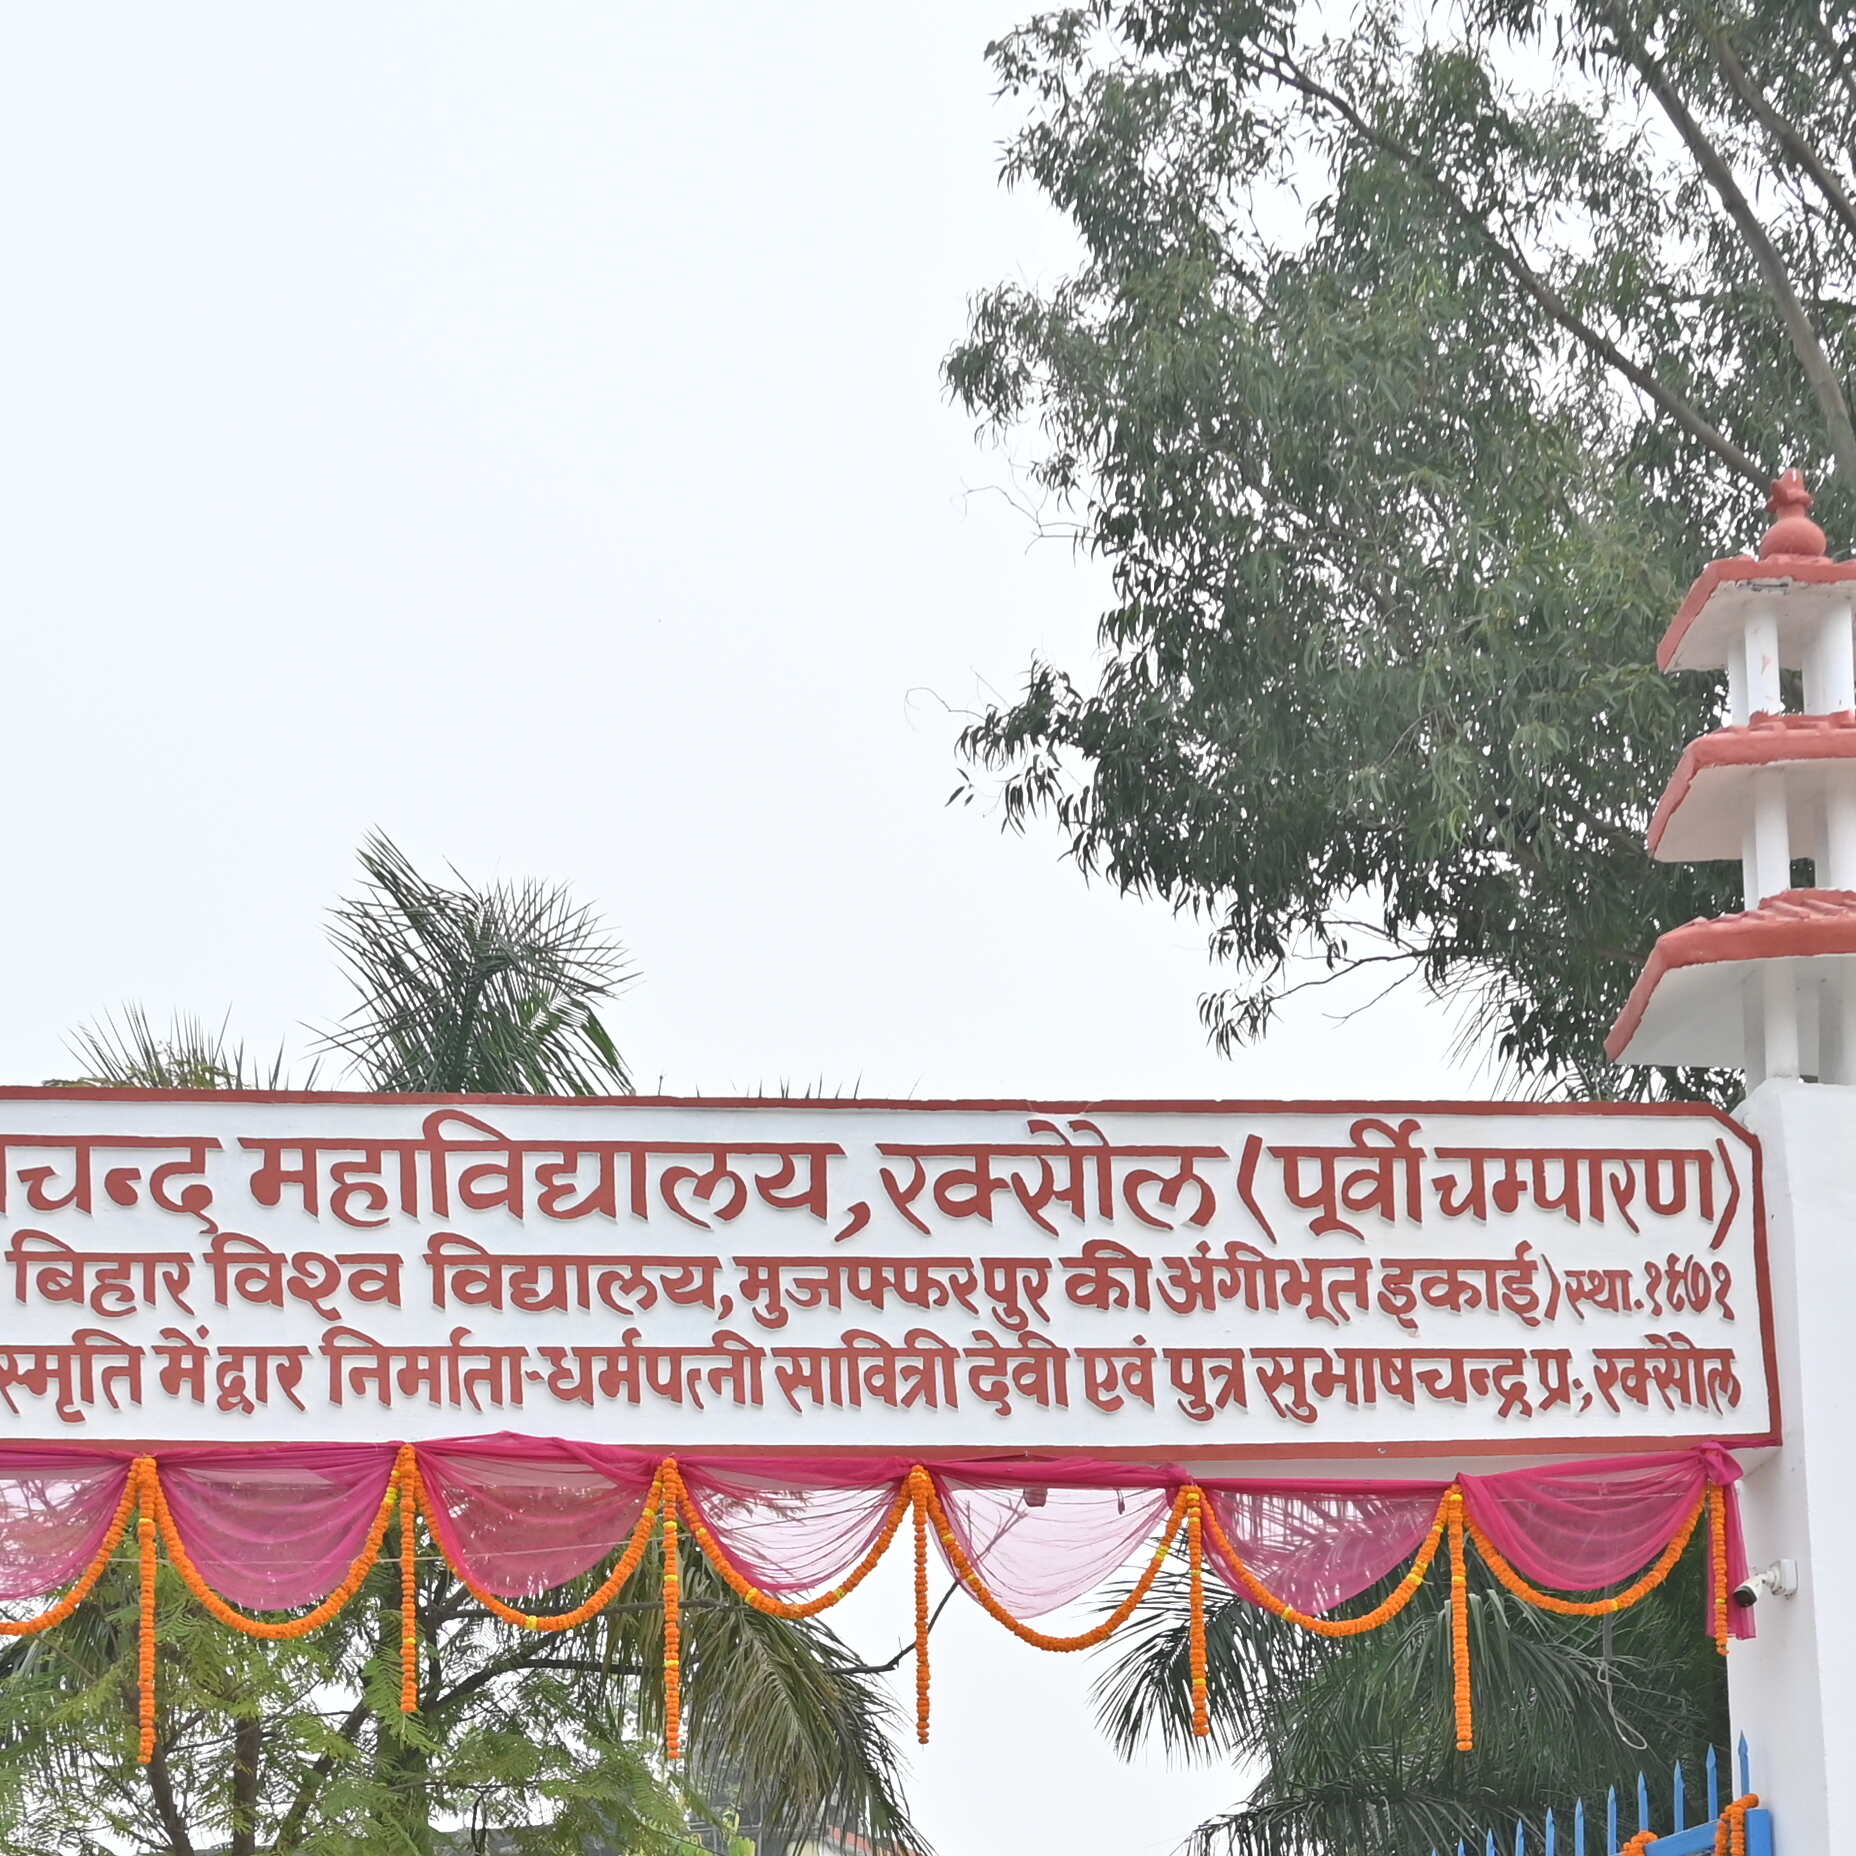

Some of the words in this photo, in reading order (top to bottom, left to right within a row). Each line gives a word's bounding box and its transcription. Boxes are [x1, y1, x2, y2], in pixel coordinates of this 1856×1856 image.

[238, 1108, 872, 1242] महाविद्यालय,
[875, 1119, 1229, 1238] रक्सौल
[4, 1228, 196, 1318] बिहार
[202, 1231, 404, 1321] विश्व
[422, 1231, 735, 1321] विद्यालय,
[1058, 1238, 1154, 1312] की
[1156, 1239, 1373, 1326] अंगीभूत
[151, 1324, 211, 1404] में
[770, 1328, 961, 1414] सावित्री
[962, 1329, 1072, 1417] देवी
[1073, 1334, 1157, 1413] एवं
[1162, 1347, 1249, 1422] पुत्र
[1591, 1331, 1743, 1416] रक्सौल
